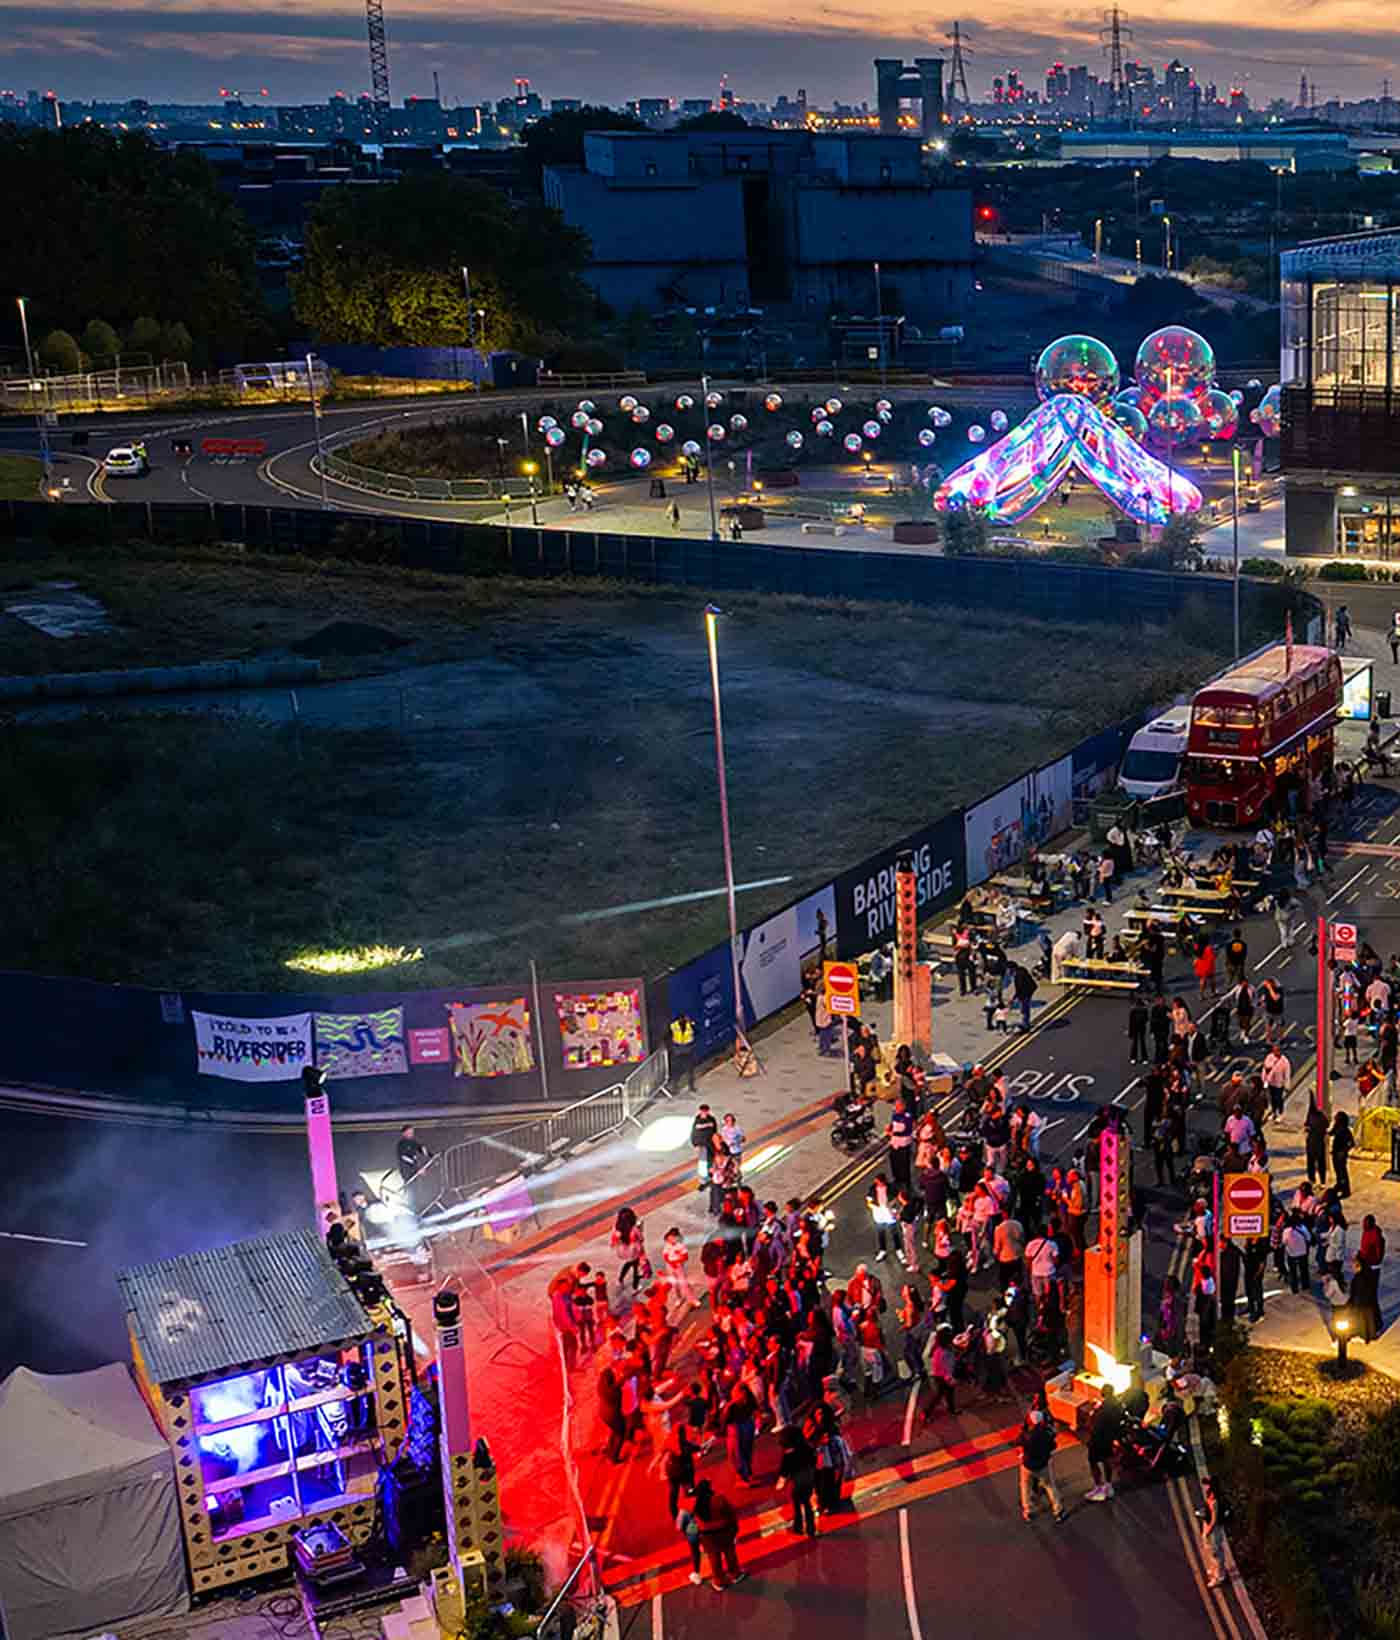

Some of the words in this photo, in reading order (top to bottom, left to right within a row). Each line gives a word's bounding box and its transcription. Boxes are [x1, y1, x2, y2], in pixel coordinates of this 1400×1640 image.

[853, 844, 930, 916] BARKNG
[868, 860, 952, 939] RIVSIDE
[213, 1036, 306, 1059] RIVERSIDER
[1007, 1070, 1095, 1102] BUS
